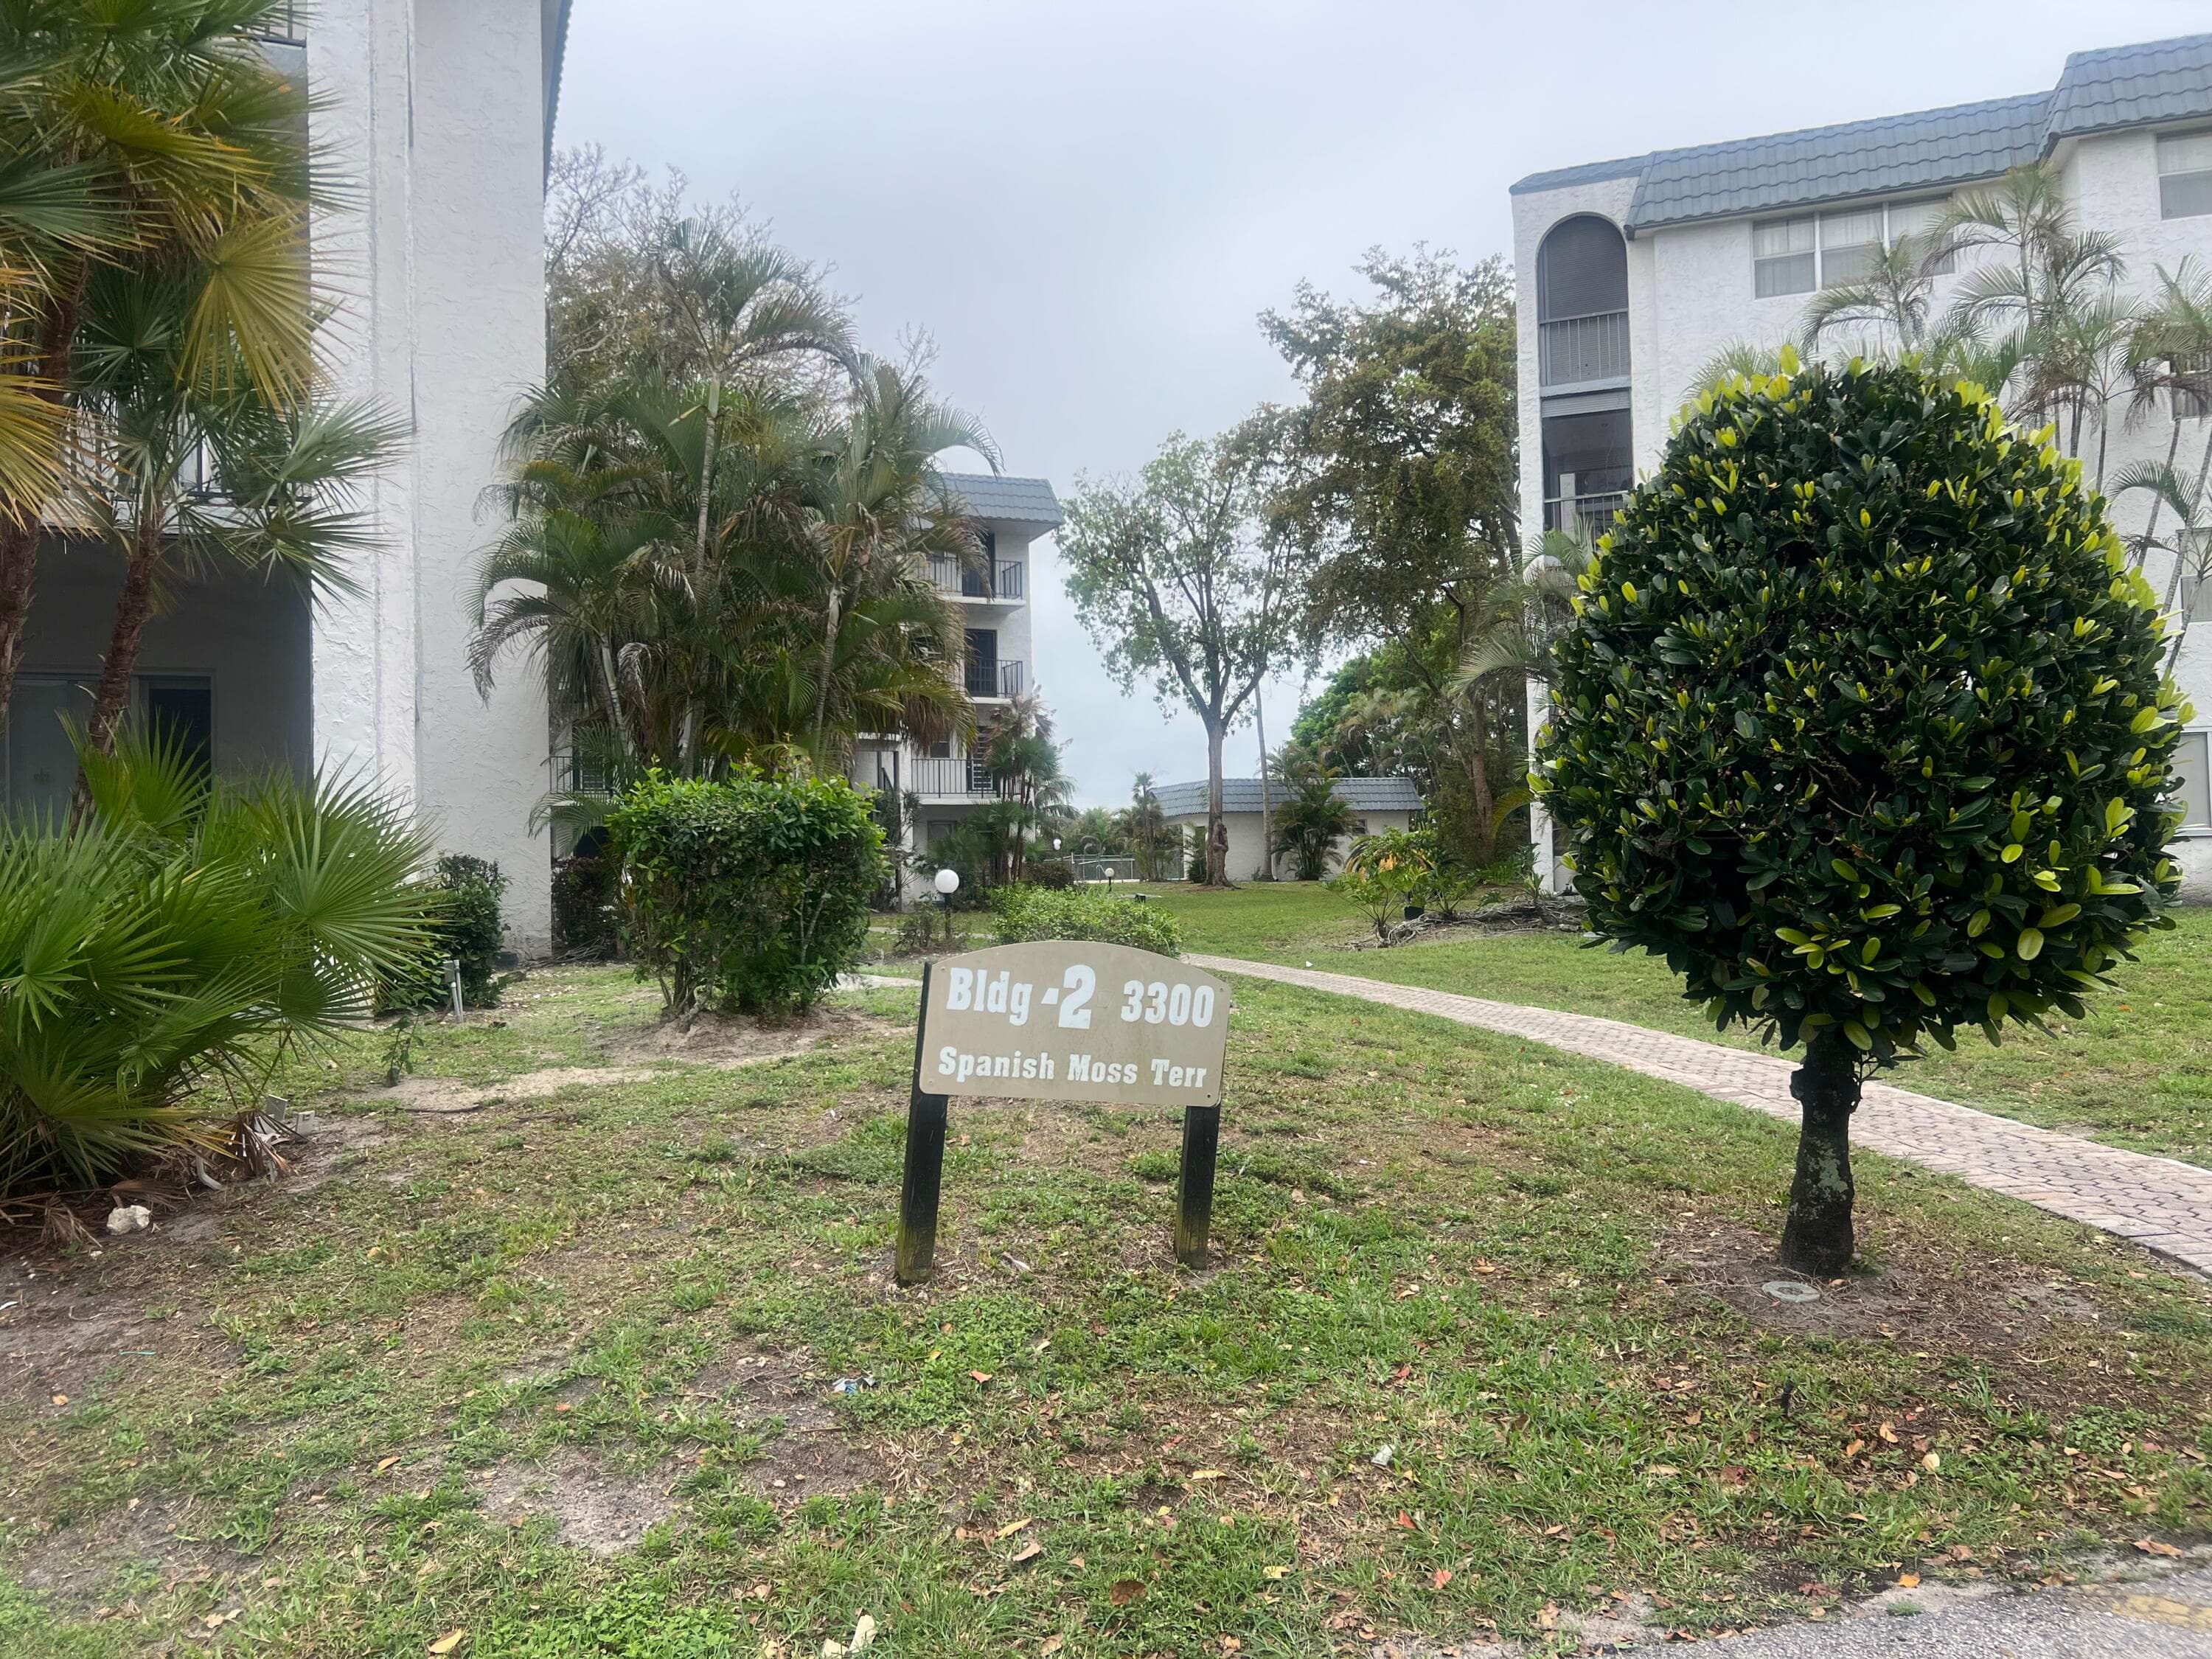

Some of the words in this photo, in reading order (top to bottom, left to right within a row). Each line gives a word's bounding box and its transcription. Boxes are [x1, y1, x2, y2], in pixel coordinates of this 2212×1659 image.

[1120, 979, 1215, 1028] 3300
[938, 1046, 1055, 1082] Spanish
[1067, 1053, 1138, 1085] Moss
[1150, 1058, 1207, 1088] Terr
